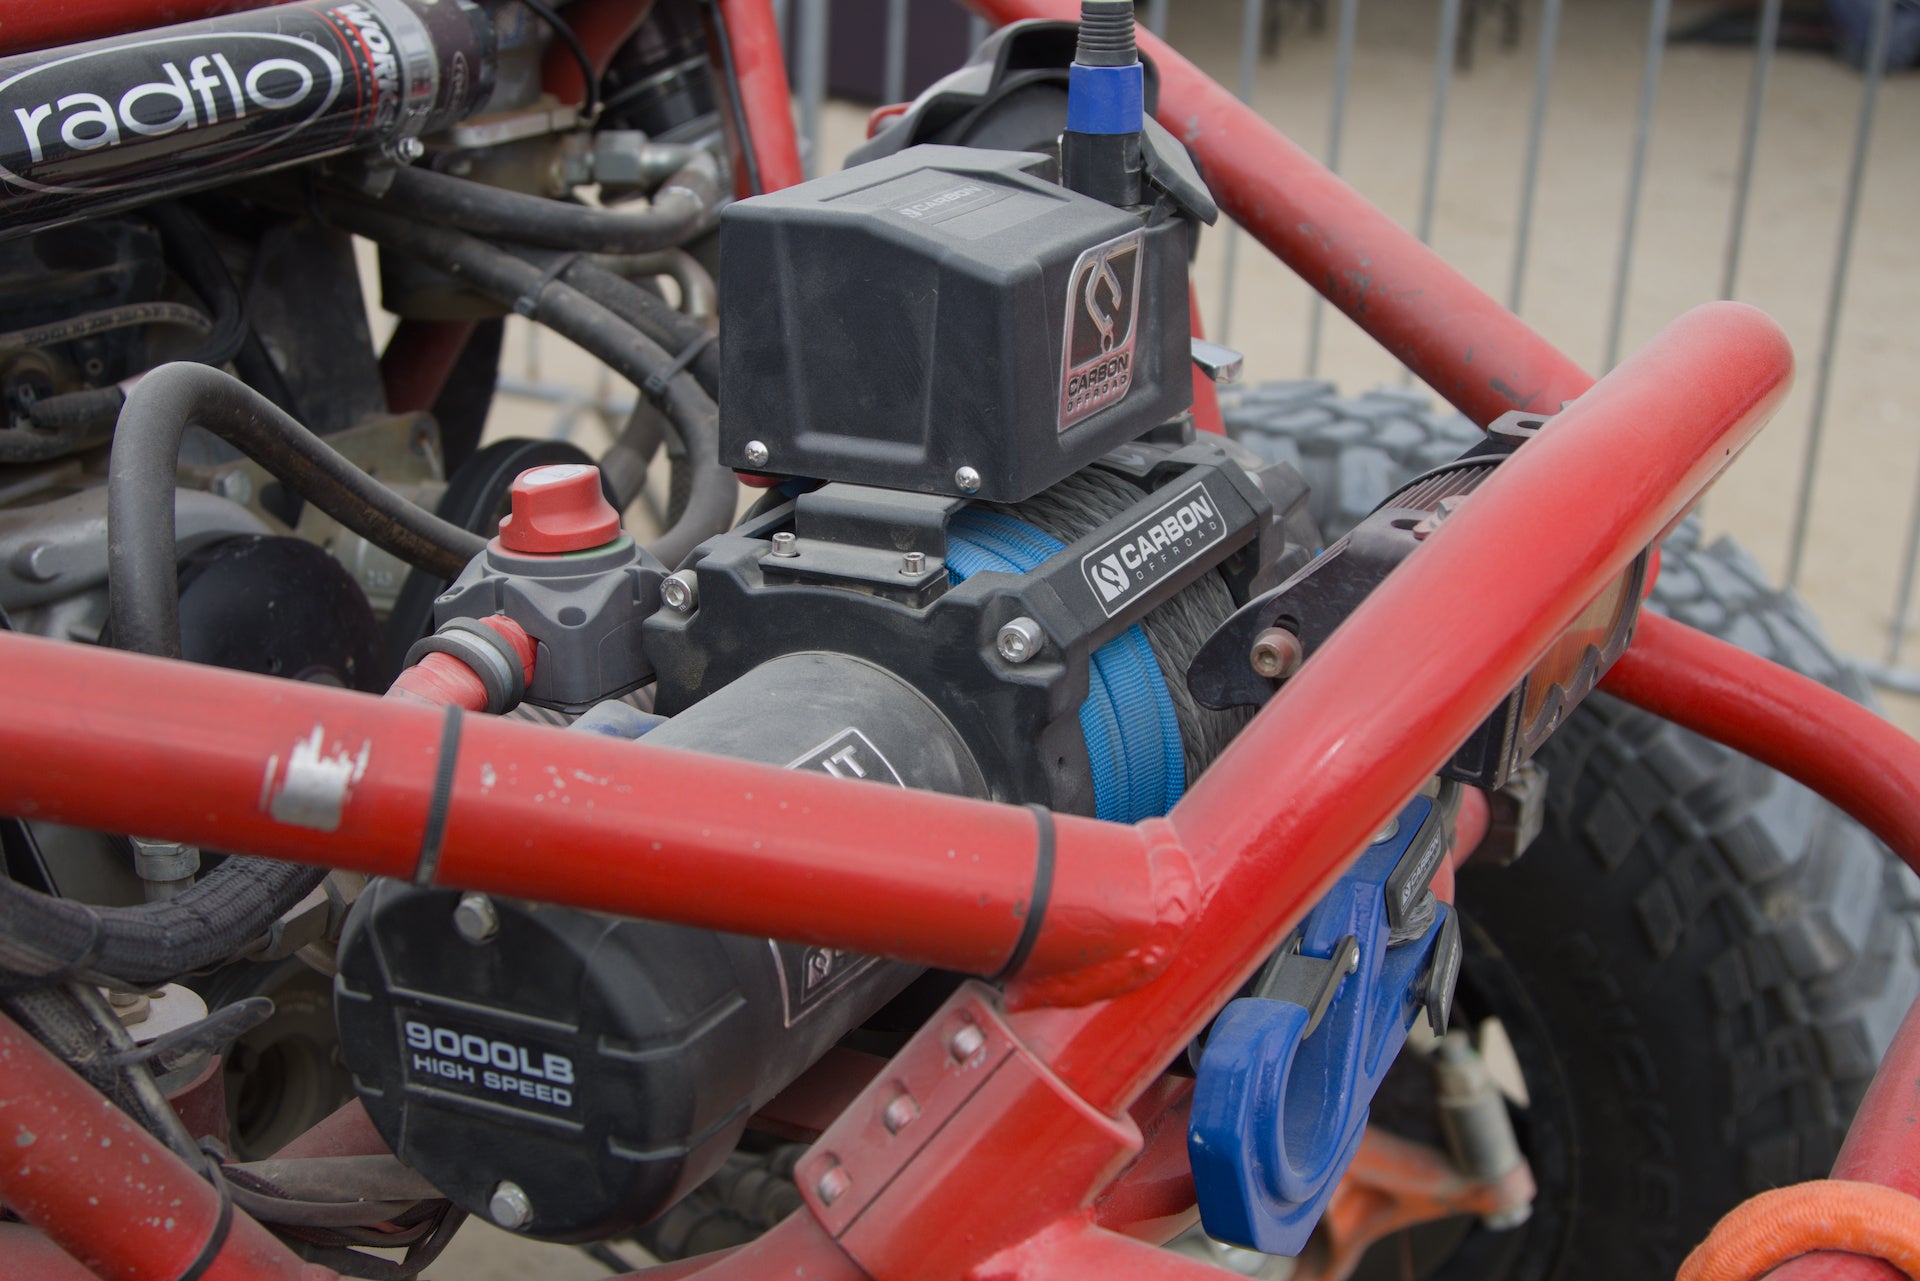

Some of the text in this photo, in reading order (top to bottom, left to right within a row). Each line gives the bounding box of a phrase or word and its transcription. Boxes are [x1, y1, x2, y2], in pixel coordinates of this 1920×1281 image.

[14, 53, 313, 163] radflo
[911, 185, 982, 212] CARBON
[1066, 374, 1129, 414] OFFROAD
[1068, 351, 1130, 398] CARBON
[1120, 495, 1214, 569] CARBON
[1136, 521, 1217, 580] OFFROAD
[405, 1021, 575, 1085] 9000LB
[413, 1053, 573, 1107] HIGH SPEED
